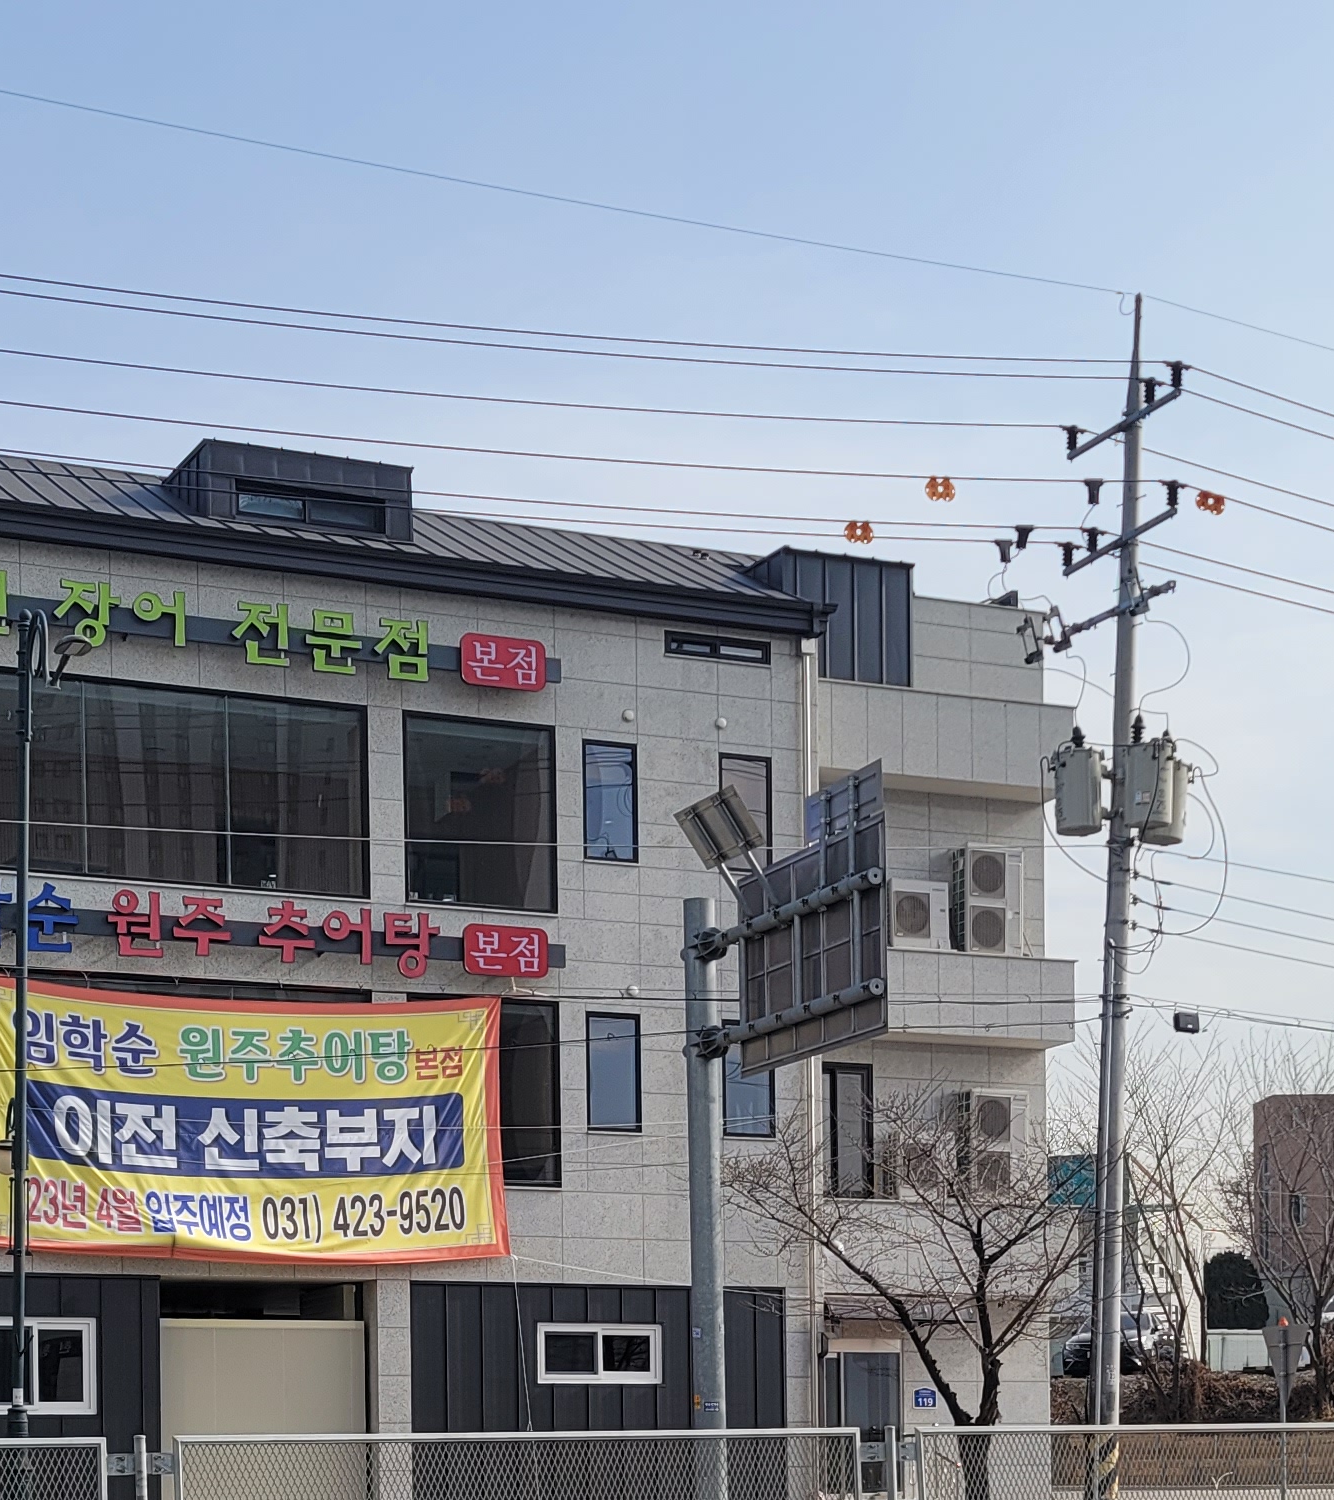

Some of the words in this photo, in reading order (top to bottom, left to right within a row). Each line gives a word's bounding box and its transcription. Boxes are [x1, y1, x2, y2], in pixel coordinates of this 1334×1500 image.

[53, 578, 187, 648] 장어
[231, 601, 430, 682] 전문점
[467, 641, 538, 685] 본점
[108, 888, 232, 958] 원주
[259, 900, 441, 979] 추어탕
[469, 931, 541, 973] 본점
[13, 1010, 157, 1076] 임학순
[54, 1095, 178, 1169] 이전
[198, 1105, 437, 1172] 신축부지
[96, 1187, 143, 1233] 4월
[145, 1190, 252, 1242] 입주예정
[262, 1194, 322, 1243] 031)
[333, 1186, 465, 1238] 423-9520
[917, 1397, 934, 1407] 119
